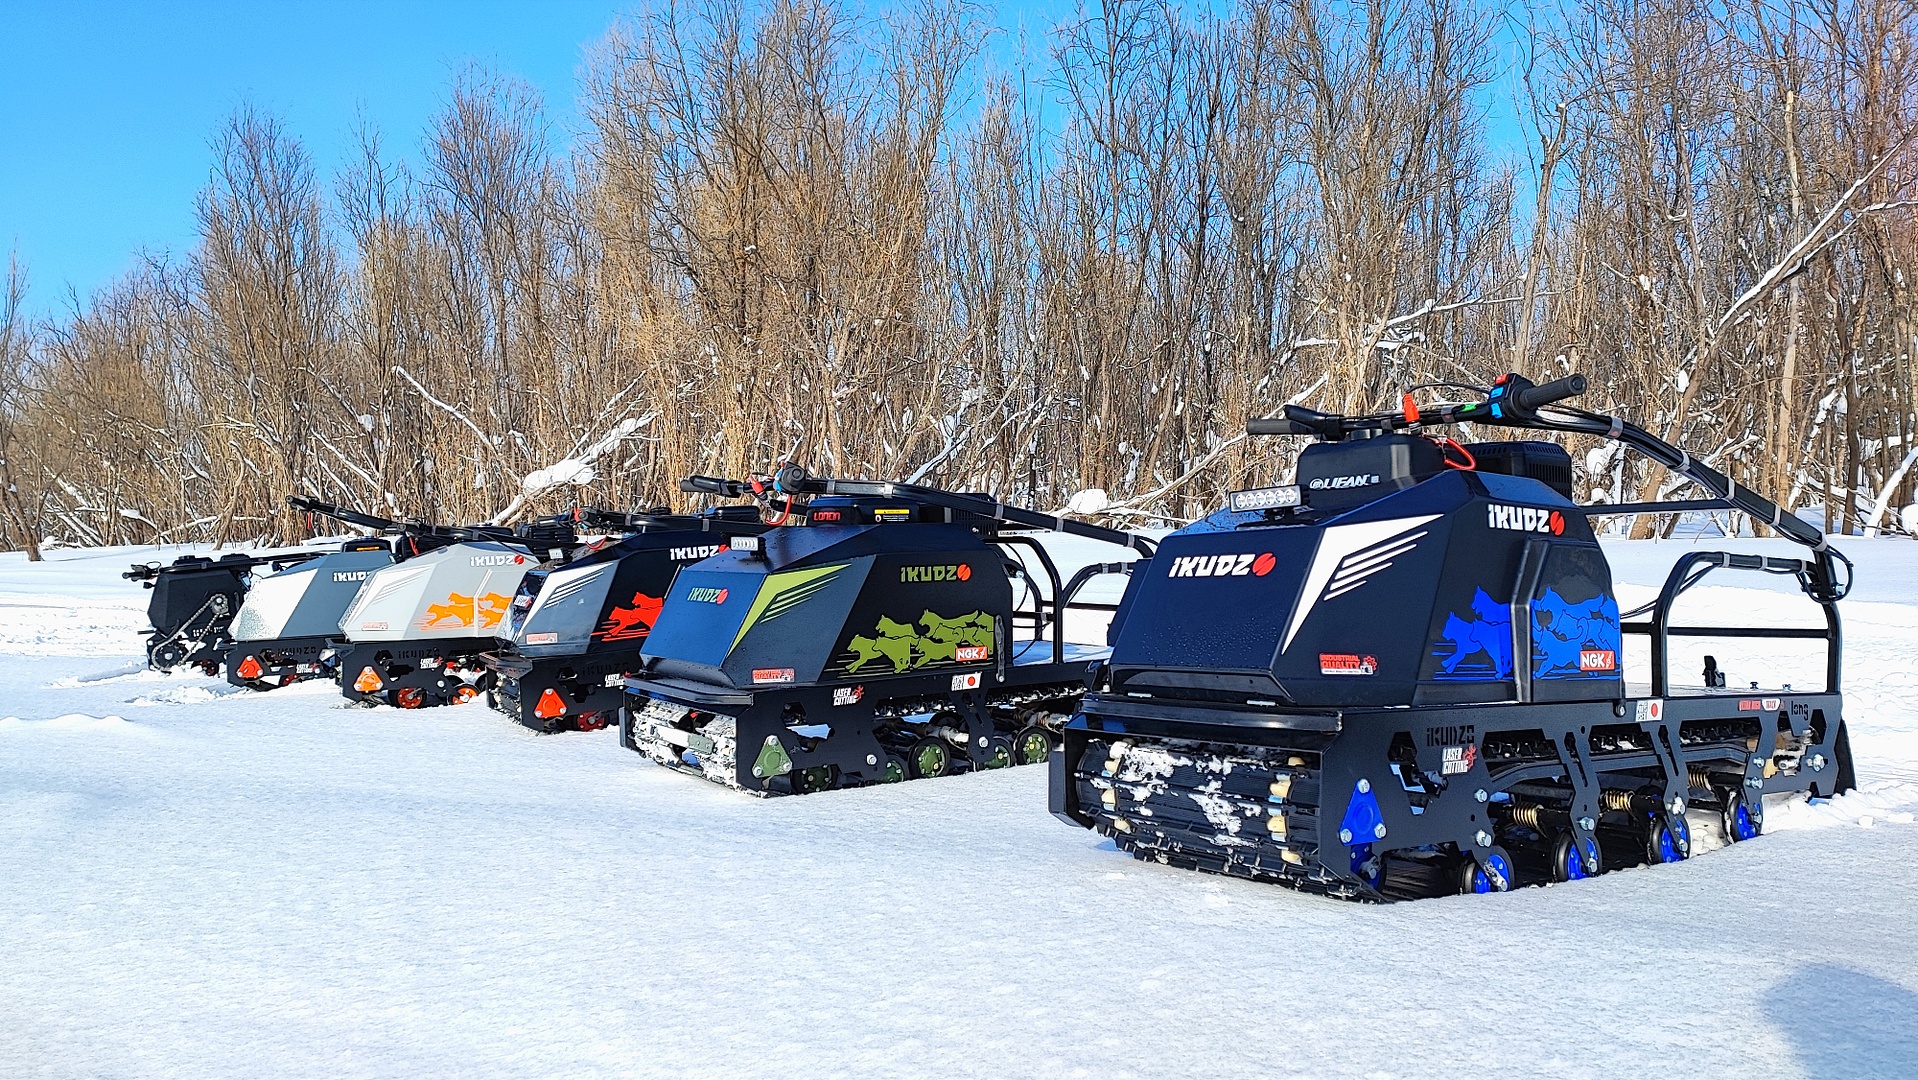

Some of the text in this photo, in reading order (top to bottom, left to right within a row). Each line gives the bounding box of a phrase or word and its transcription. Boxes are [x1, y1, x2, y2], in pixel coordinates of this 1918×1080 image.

[1324, 474, 1370, 489] LIFAN
[957, 648, 980, 660] NGK
[1581, 653, 1606, 668] NGK
[1321, 661, 1360, 669] QUALITY
[833, 688, 852, 697] LASER
[1791, 701, 1808, 720] long
[1442, 747, 1463, 761] LASER
[1442, 760, 1469, 774] CUTTING
